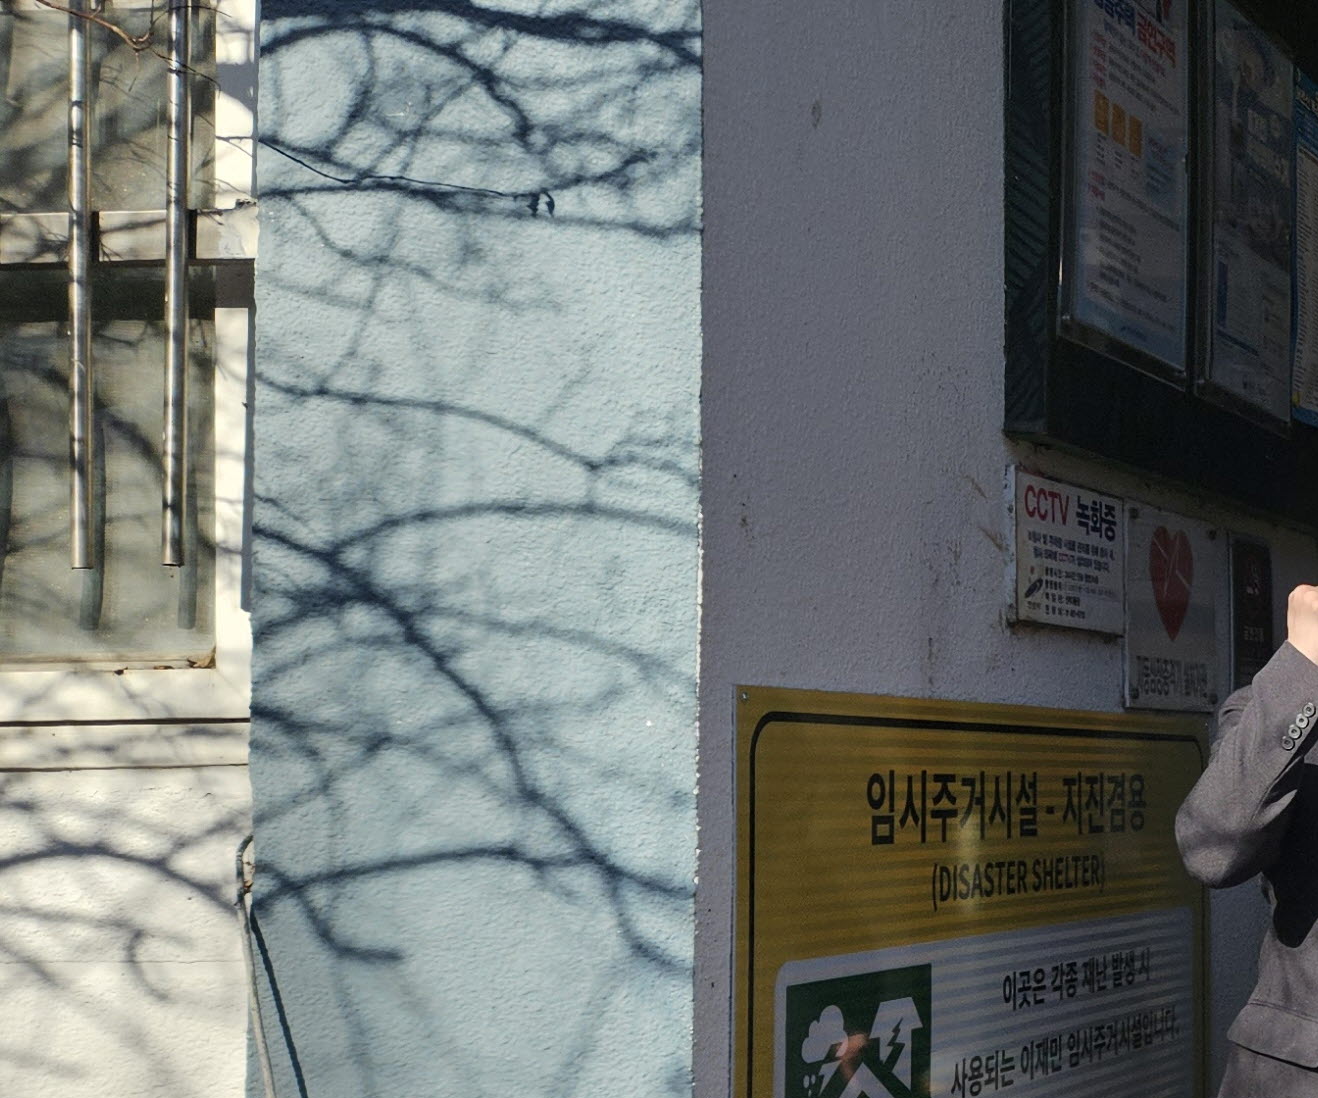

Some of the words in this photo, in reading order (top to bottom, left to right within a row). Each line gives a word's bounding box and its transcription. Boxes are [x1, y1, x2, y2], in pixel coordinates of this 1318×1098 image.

[1025, 484, 1069, 525] CCTV
[1076, 496, 1116, 542] 녹화중
[867, 770, 1037, 846] 임시주거시설
[1063, 772, 1146, 834] 지진겸용
[931, 862, 1027, 912] (DISASTER
[1032, 855, 1104, 892] SHELTER)
[1003, 970, 1045, 1011] 이곳은
[1050, 962, 1078, 998] 각종
[1083, 955, 1110, 993] 재난
[1112, 950, 1136, 987] 발생
[1020, 1036, 1062, 1080] 이재민
[1066, 1006, 1180, 1066] 임시주거시설입니다.
